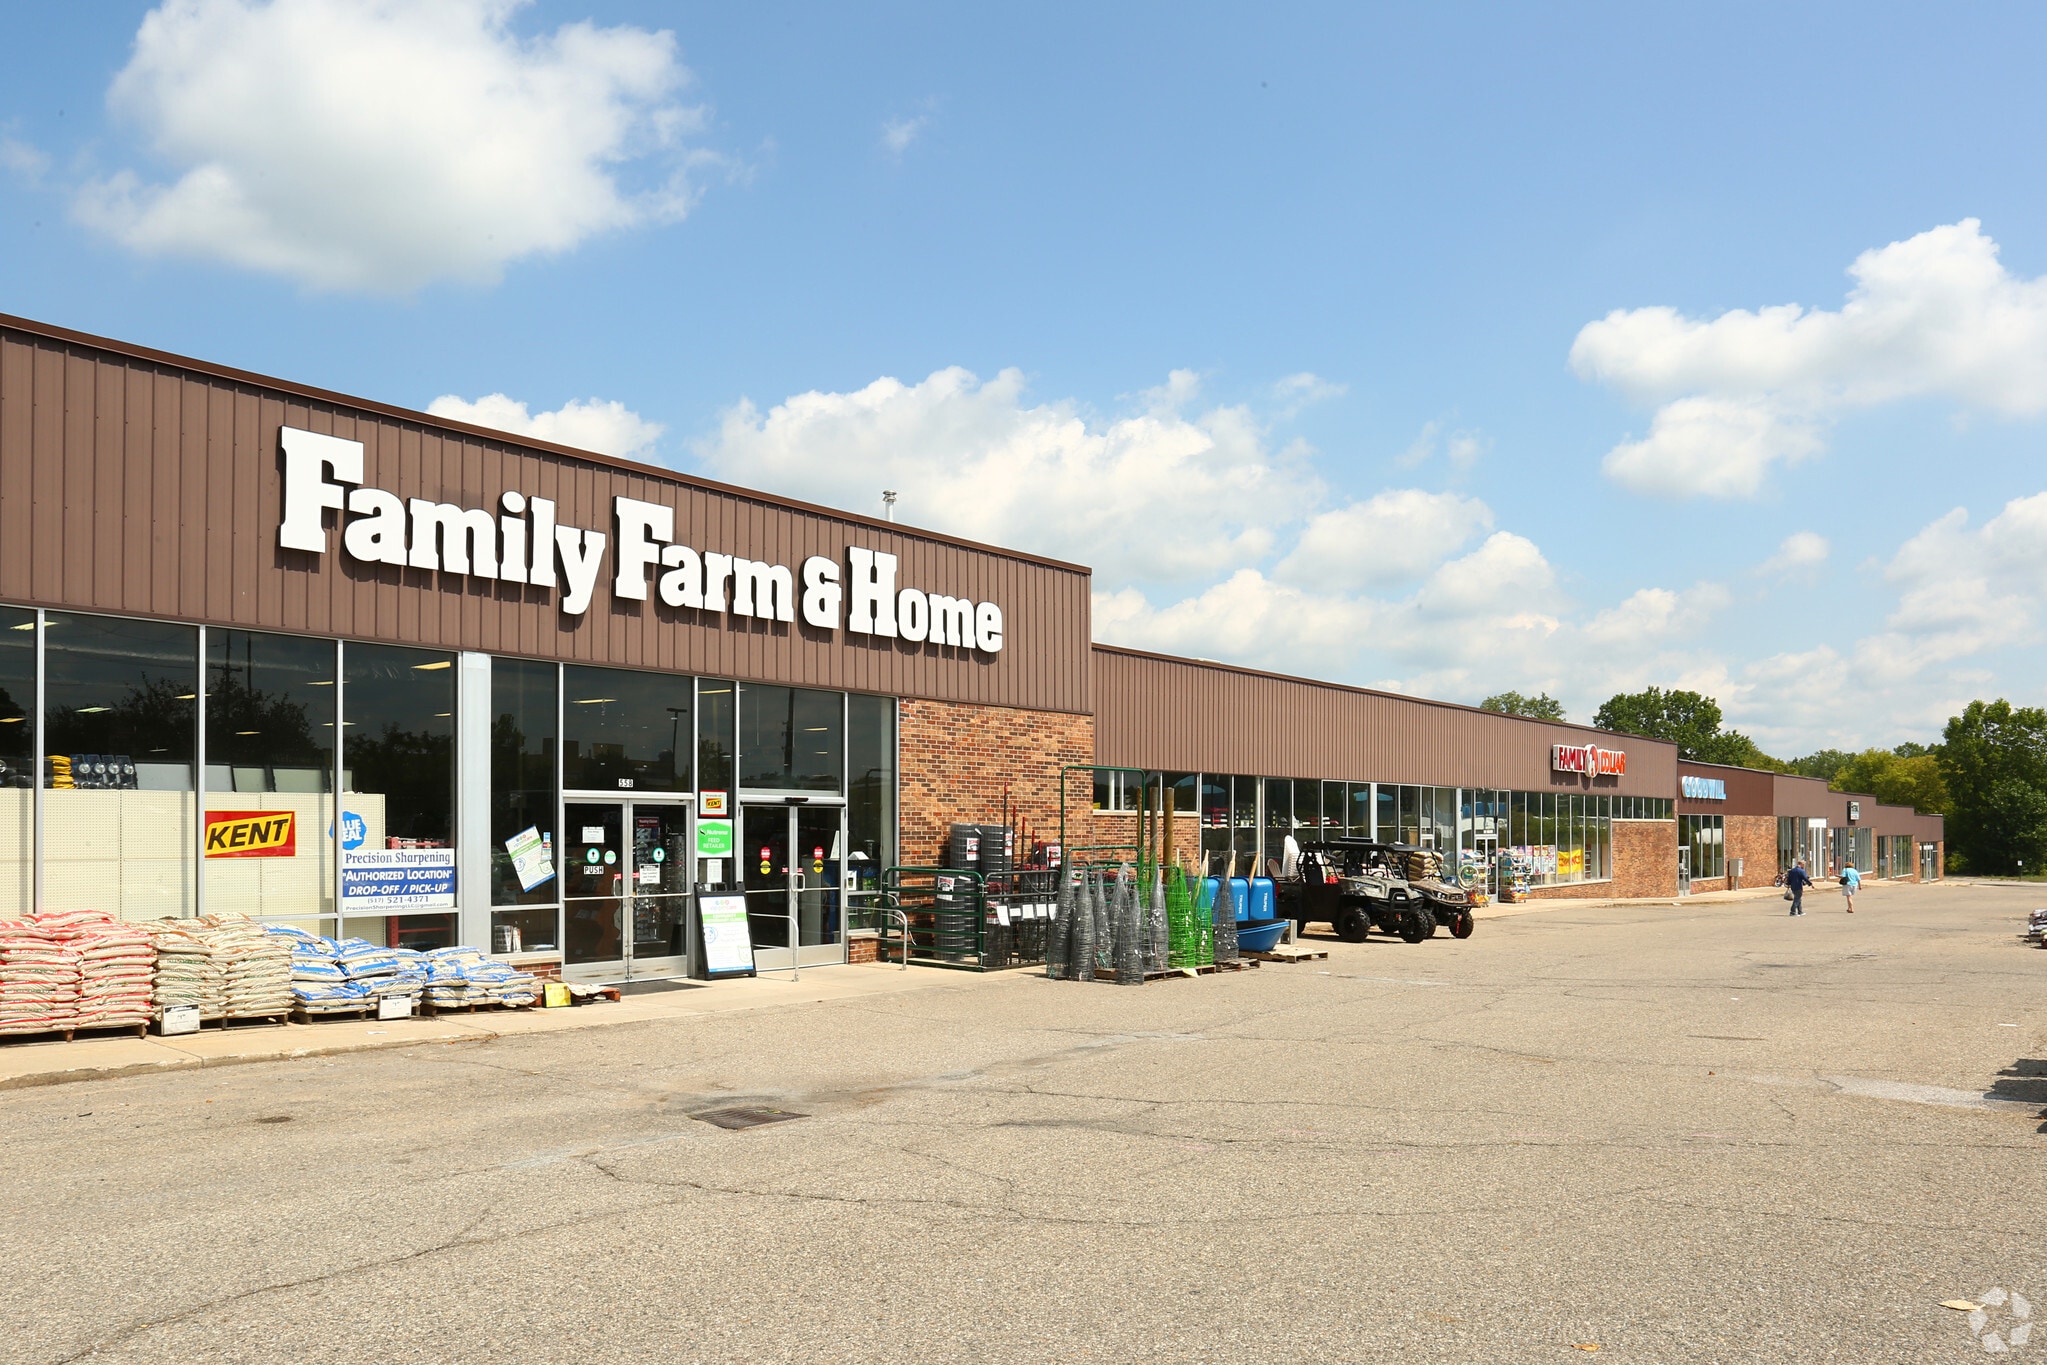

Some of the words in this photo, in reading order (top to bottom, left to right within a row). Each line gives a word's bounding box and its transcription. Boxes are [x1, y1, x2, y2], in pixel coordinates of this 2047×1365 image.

[279, 425, 605, 615] Family
[614, 495, 794, 622] Farm
[802, 555, 841, 629] &
[846, 545, 1003, 653] Home
[1559, 746, 1587, 771] FAMILY
[1601, 750, 1626, 775] DOLLAR
[619, 779, 633, 787] 558
[1682, 776, 1727, 800] GOODWILL
[342, 819, 361, 831] LUE
[207, 818, 289, 850] KENT
[342, 831, 362, 842] EAL
[345, 853, 392, 864] Precision
[395, 851, 451, 865] Sharpening
[584, 866, 604, 874] PUSH
[348, 884, 400, 896] DROP-OFF
[401, 884, 408, 894] /
[409, 883, 448, 893] PICK-UP
[387, 895, 429, 904] 521-4371
